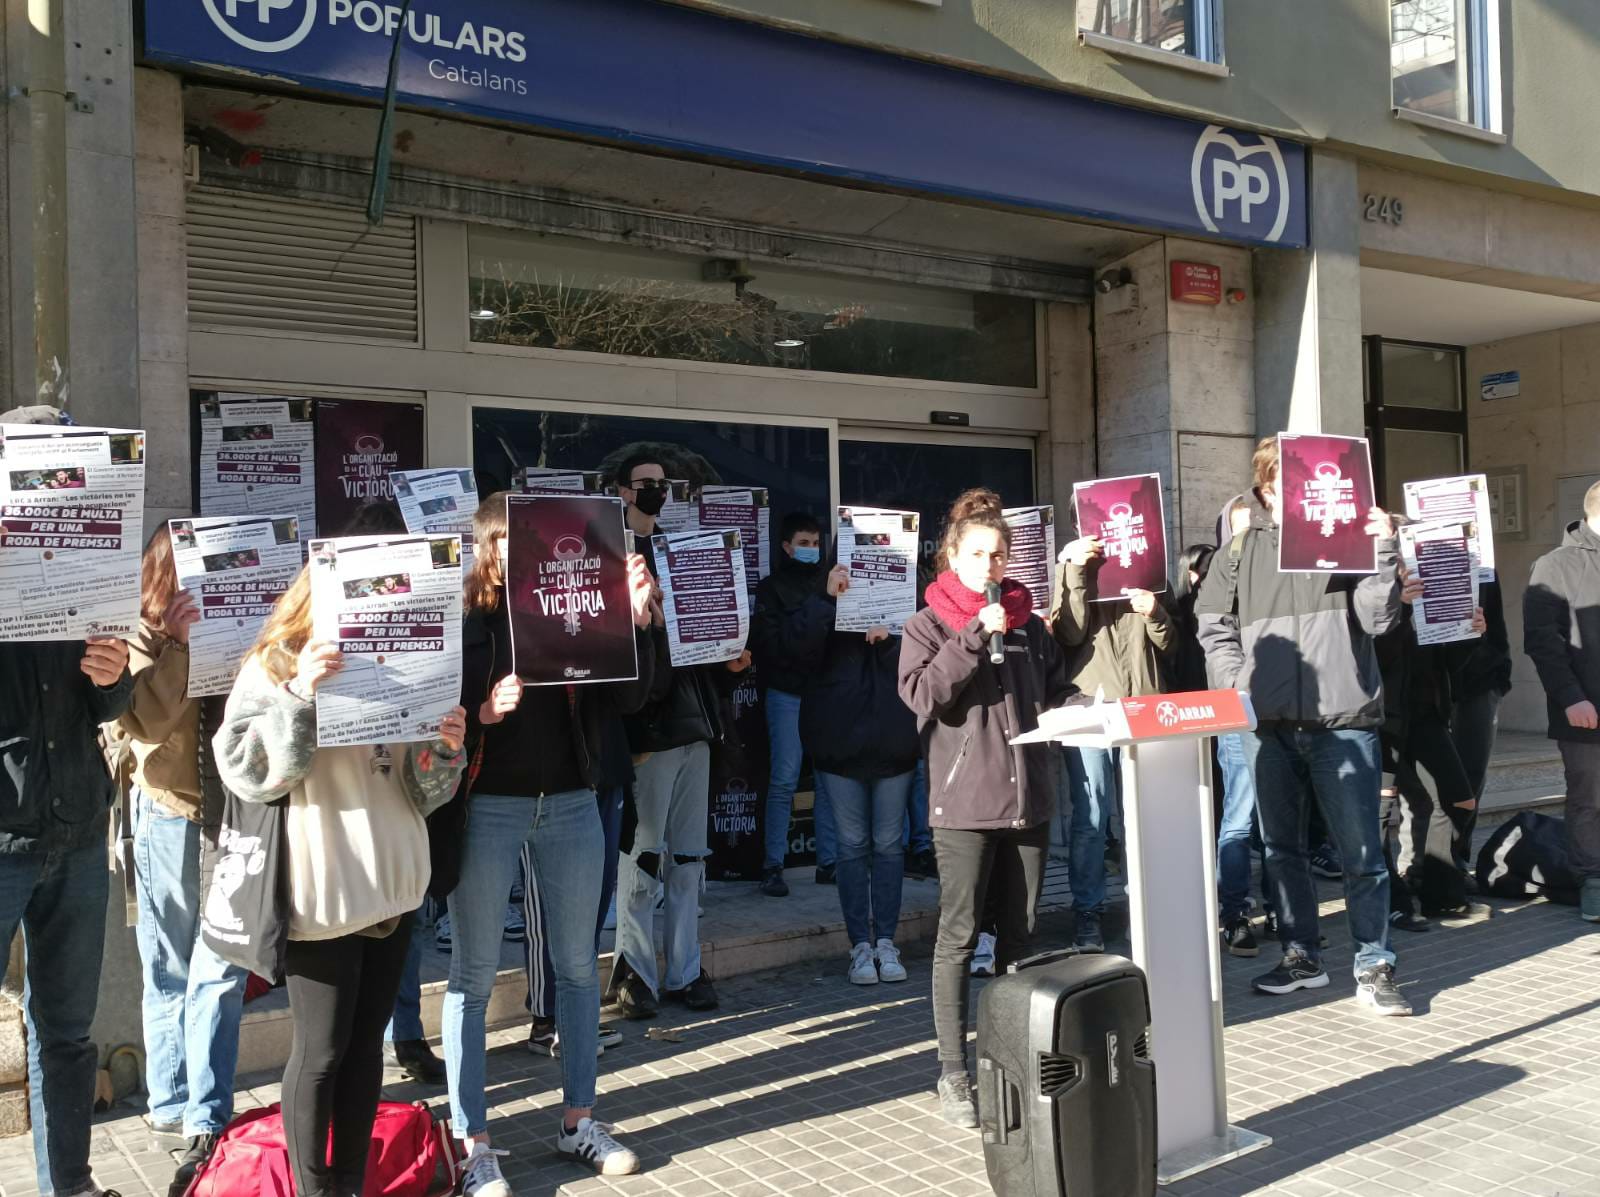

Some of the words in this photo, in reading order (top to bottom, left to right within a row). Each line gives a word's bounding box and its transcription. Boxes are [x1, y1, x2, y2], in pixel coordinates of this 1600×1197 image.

[328, 0, 527, 62] POPULARS
[428, 59, 528, 95] Catalans
[1213, 158, 1270, 224] PP
[1363, 194, 1403, 227] 249
[218, 452, 256, 460] 36.000€
[270, 454, 298, 462] MULTA
[358, 464, 382, 478] CLAU
[220, 474, 244, 482] RODA
[260, 476, 299, 484] PREMSA?
[4, 506, 59, 518] 36.000€
[62, 508, 78, 518] DE
[80, 509, 119, 519] MULTA
[30, 522, 56, 532] PER
[58, 523, 84, 532] UNA
[5, 536, 40, 546] RODA
[43, 538, 60, 546] DE
[62, 538, 119, 548] PREMSA?
[538, 555, 601, 574] L'ORGANITZACIÓ
[548, 576, 554, 584] LA
[556, 572, 583, 590] CLAU
[593, 577, 599, 585] LA
[204, 583, 243, 593] 36.000€
[245, 583, 256, 591] DE
[258, 582, 287, 590] MULTA
[224, 596, 242, 604] PER
[532, 588, 606, 617] VICTÒRIA
[208, 608, 232, 618] RODA
[235, 608, 248, 616] DE
[340, 614, 388, 623] 36.000€
[392, 614, 405, 622] DE
[408, 612, 441, 622] MULTA
[102, 624, 131, 632] ARRAN
[364, 627, 385, 637] PER
[388, 626, 411, 636] UNA
[343, 642, 374, 651] RODA
[376, 642, 390, 651] DE
[393, 641, 442, 650] PREMSA?
[1179, 705, 1216, 720] ARRAN
[726, 802, 744, 814] CLAU
[711, 812, 756, 836] VICTÒRIA
